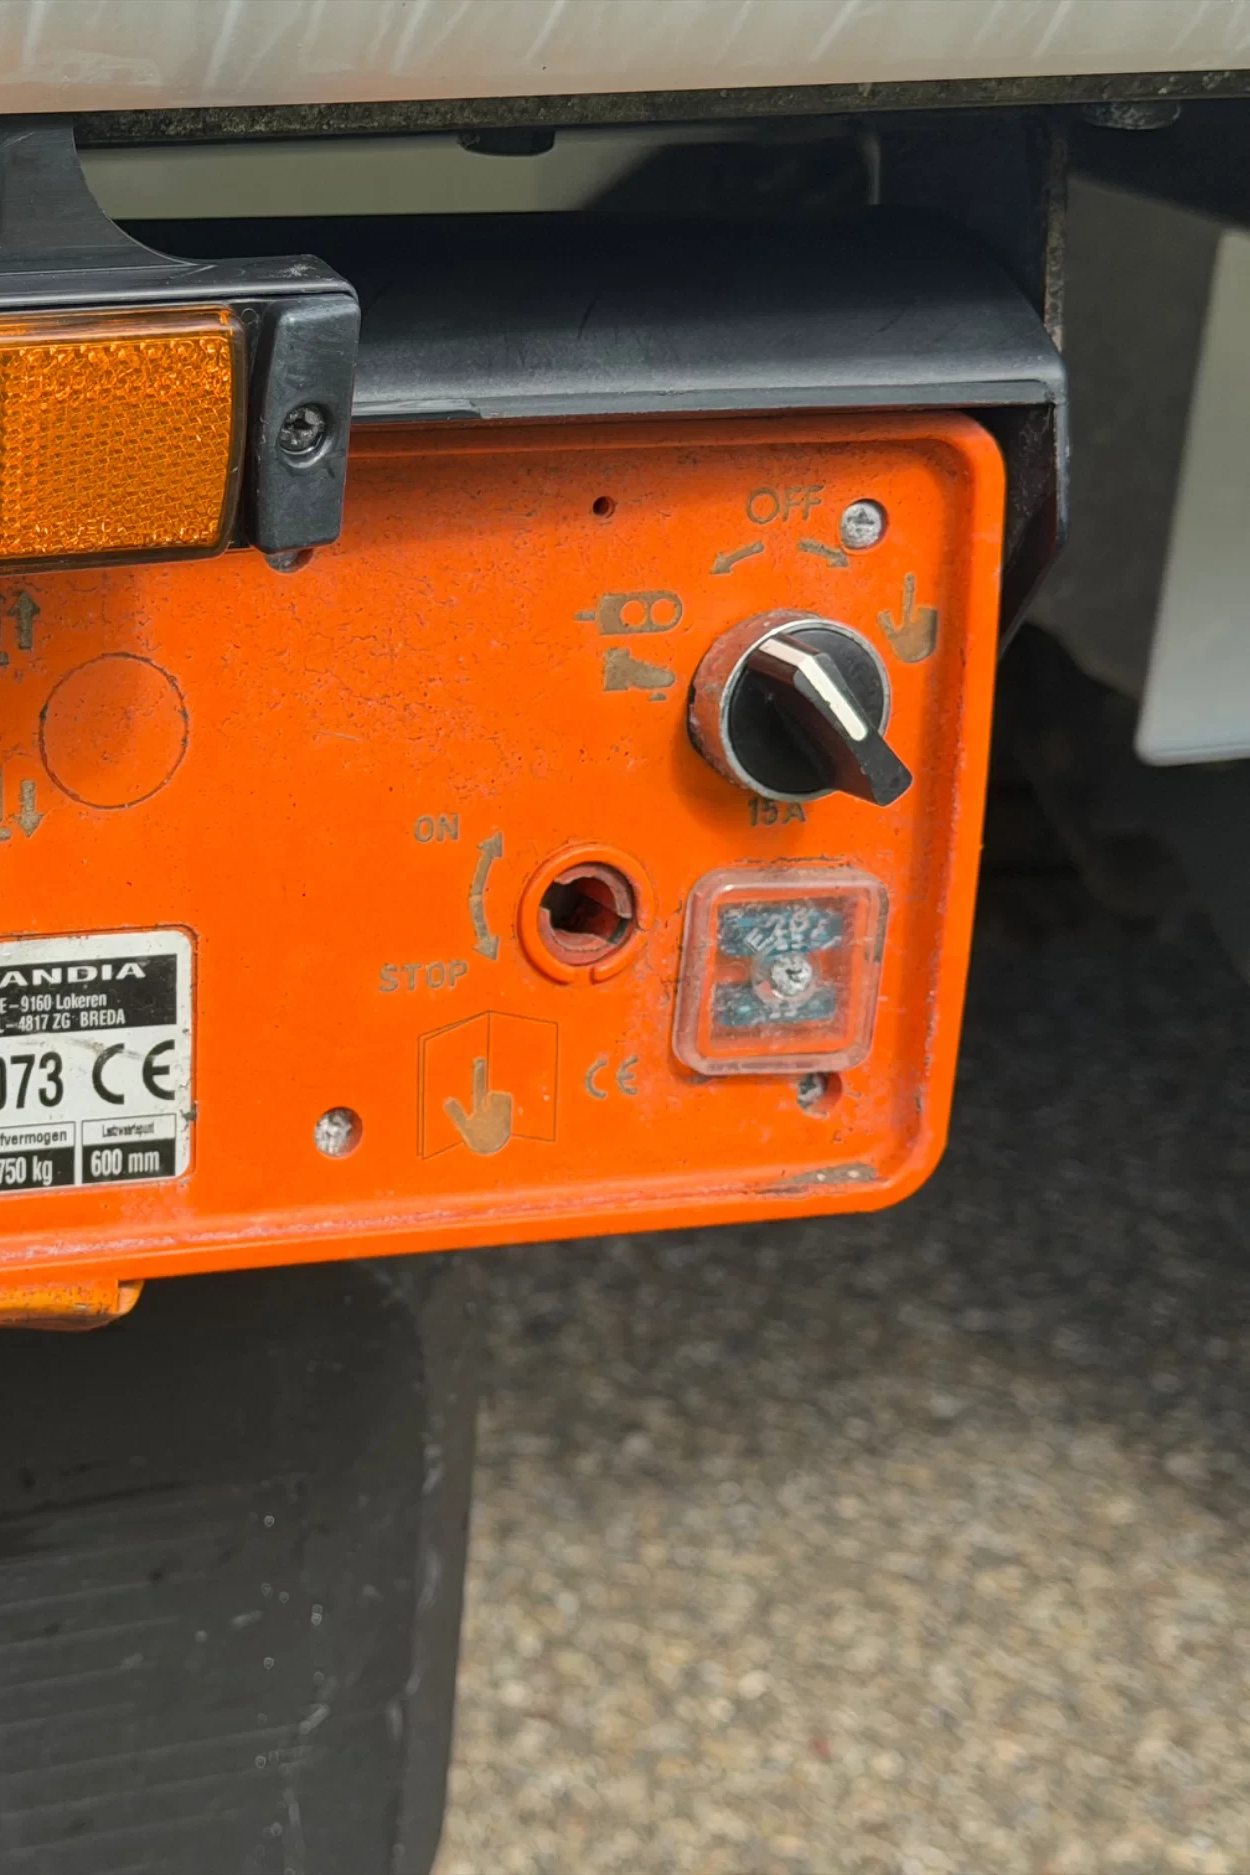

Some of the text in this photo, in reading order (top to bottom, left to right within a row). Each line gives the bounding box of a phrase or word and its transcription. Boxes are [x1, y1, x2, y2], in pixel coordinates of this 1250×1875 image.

[747, 484, 825, 524] OFF
[748, 796, 806, 827] 15A
[414, 813, 459, 842] ON
[379, 960, 468, 992] STOP
[55, 992, 108, 1010] Lokeren
[51, 1014, 71, 1029] ZG
[79, 1008, 126, 1027] BREDA
[92, 1039, 176, 1105] CE
[31, 1154, 53, 1186] kg
[90, 1147, 160, 1178] 600 mm
